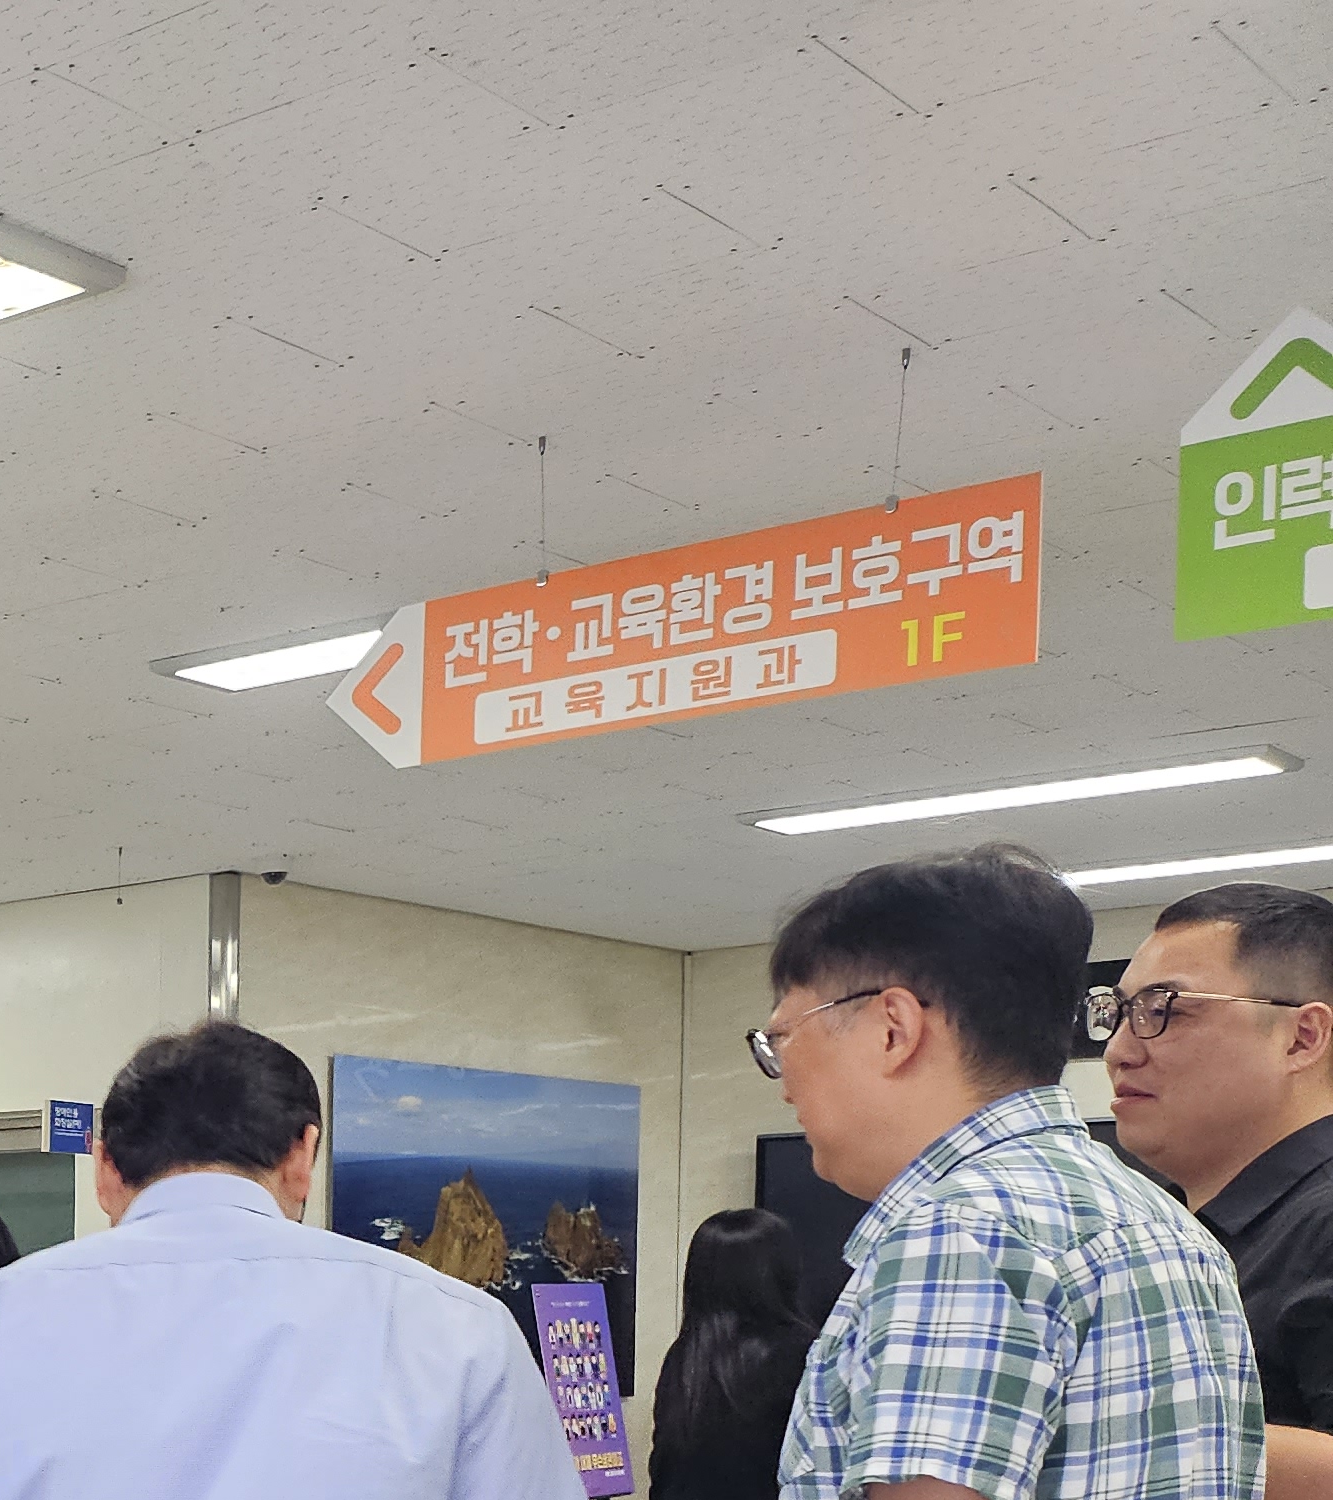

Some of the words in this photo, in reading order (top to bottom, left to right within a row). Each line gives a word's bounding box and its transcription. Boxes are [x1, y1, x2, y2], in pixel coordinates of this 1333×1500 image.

[444, 561, 774, 689] 전학·교육환경
[790, 511, 1025, 622] 보호구역
[899, 611, 967, 668] 1F
[503, 643, 803, 734] 교육지원과
